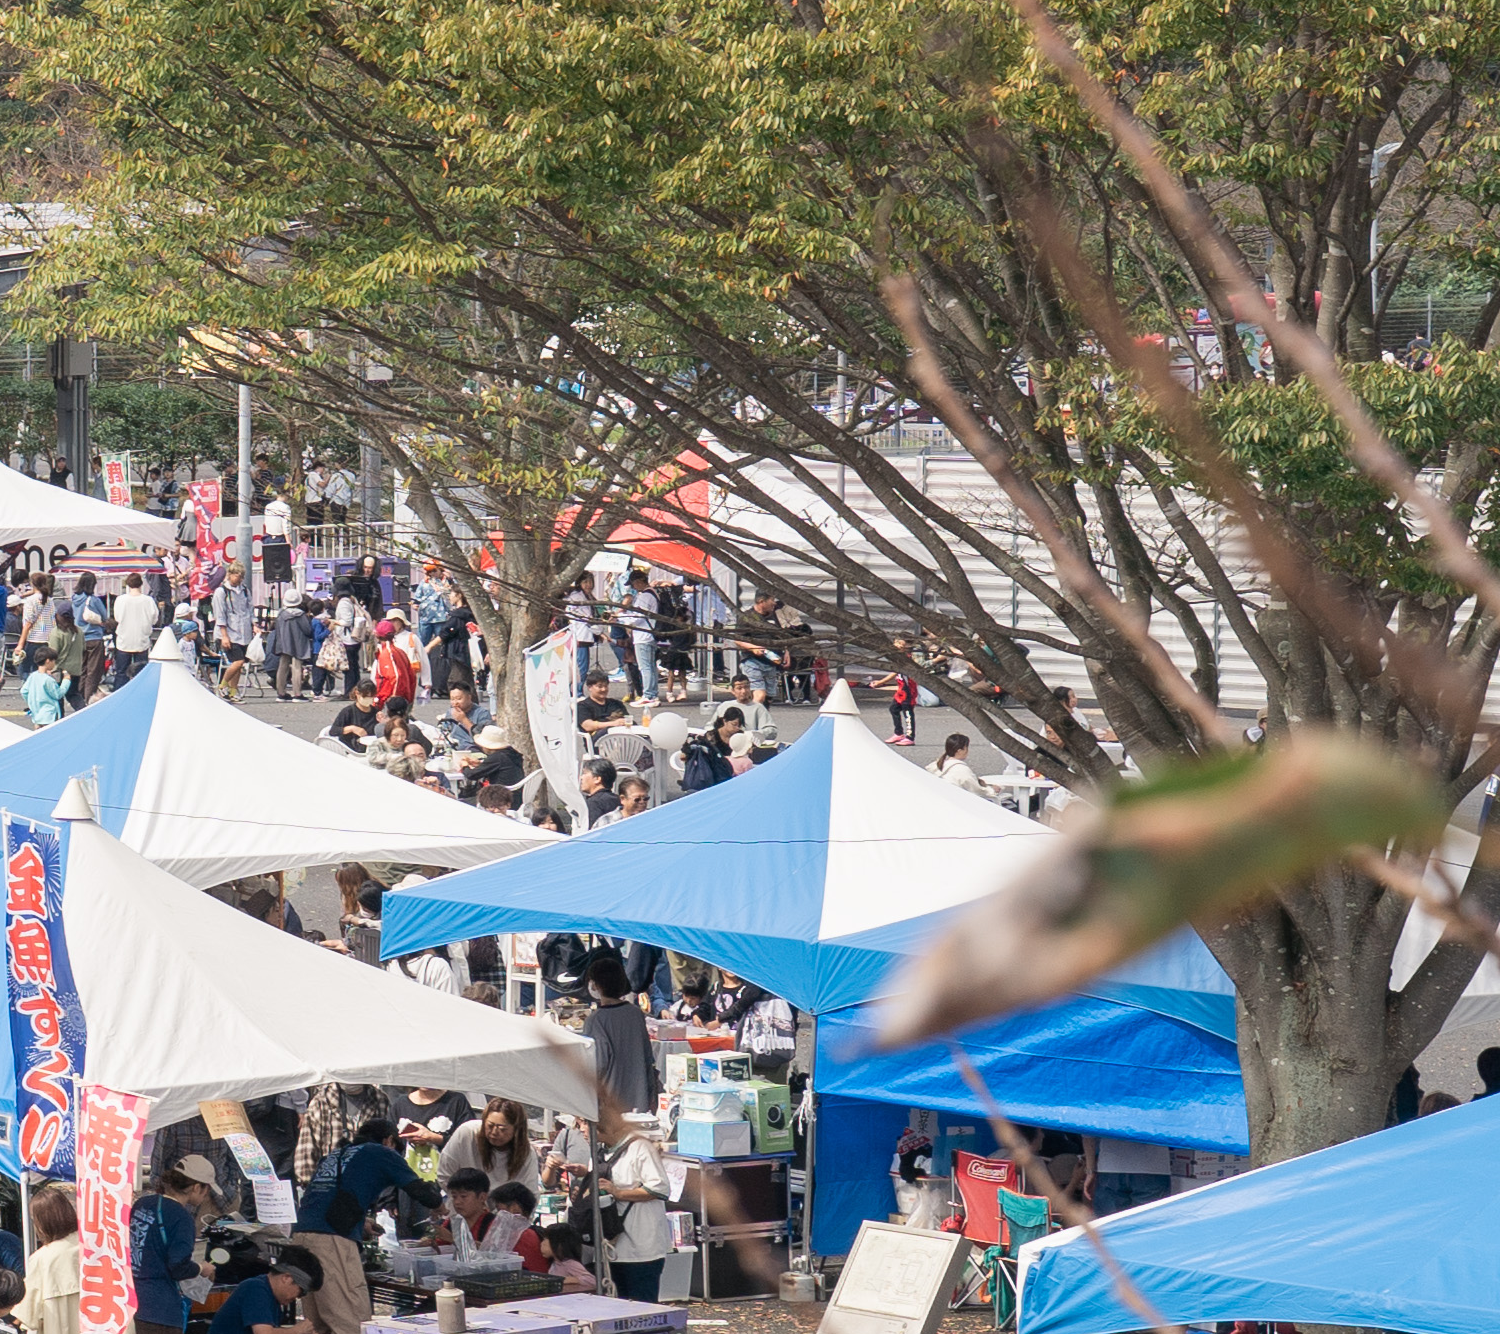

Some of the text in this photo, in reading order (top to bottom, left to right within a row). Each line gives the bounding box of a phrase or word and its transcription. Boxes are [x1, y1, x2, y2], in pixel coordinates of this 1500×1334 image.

[6, 842, 72, 1170] 金魚すくい
